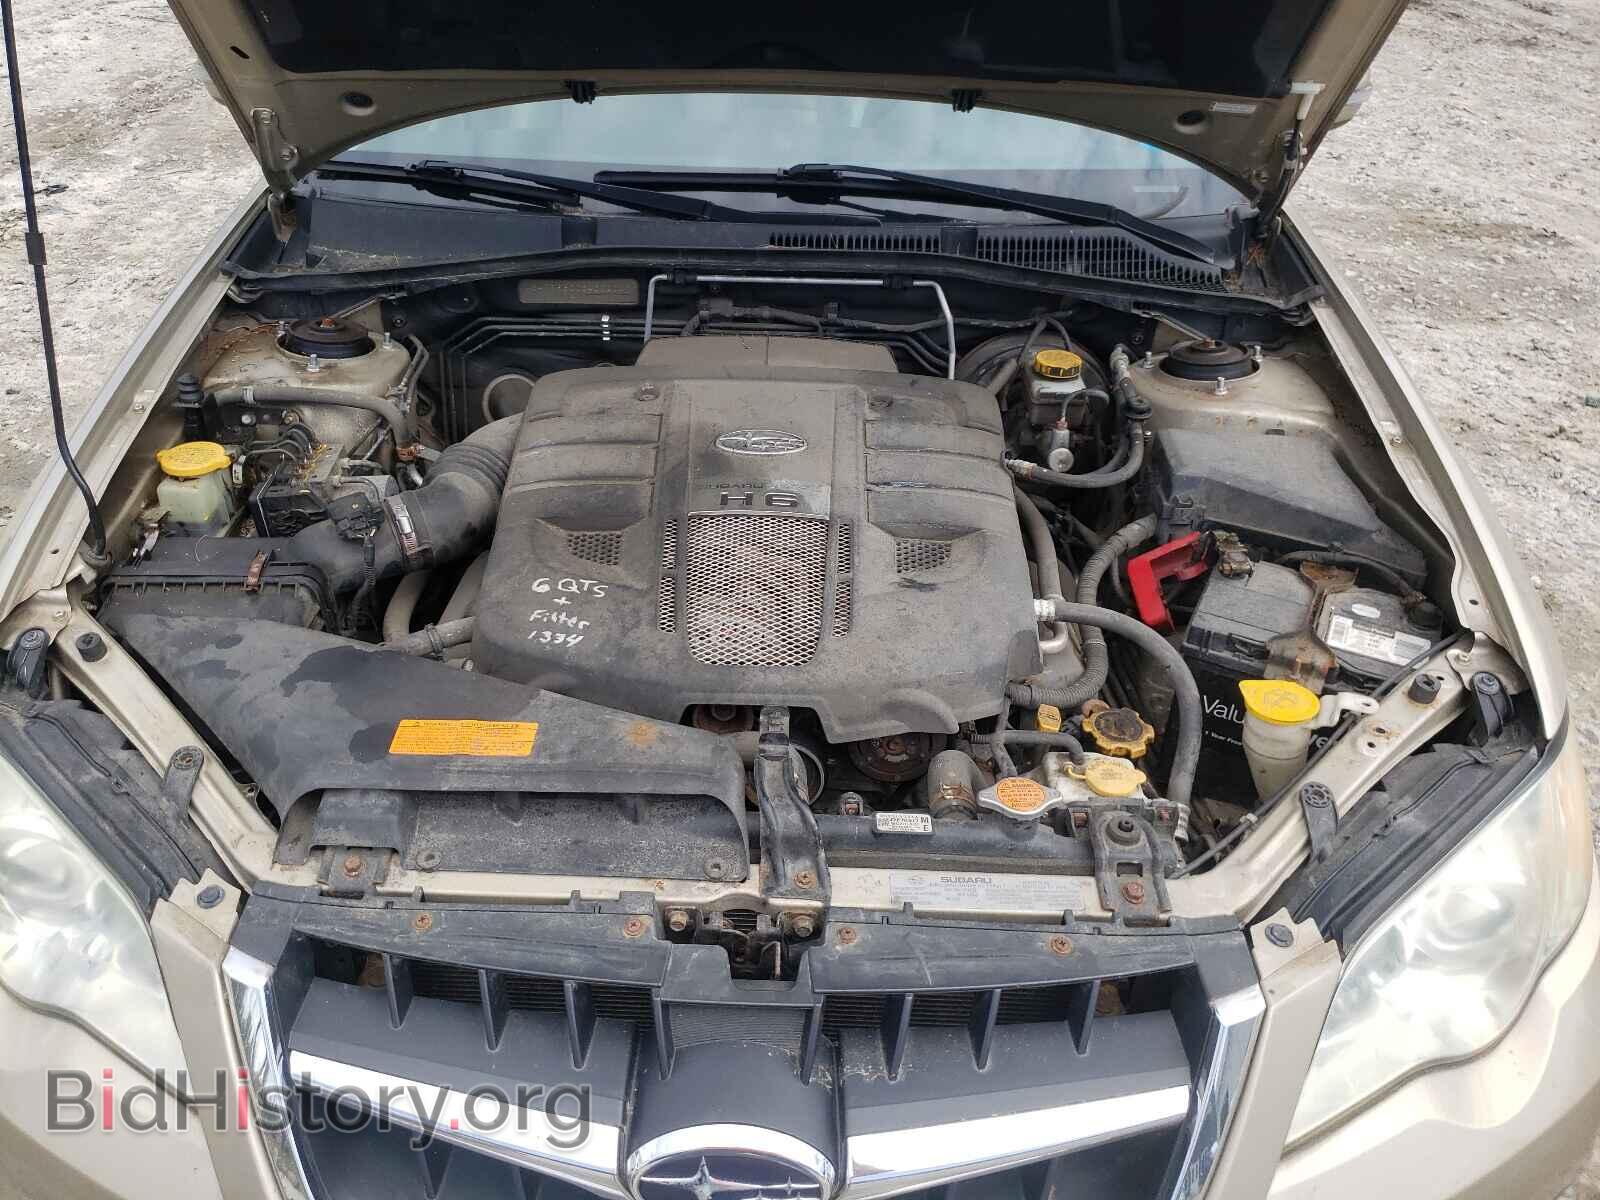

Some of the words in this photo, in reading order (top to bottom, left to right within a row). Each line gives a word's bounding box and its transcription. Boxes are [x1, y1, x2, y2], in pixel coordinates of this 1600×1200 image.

[532, 578, 550, 593] 6
[558, 578, 608, 597] QTS
[1203, 695, 1244, 724] Valu
[940, 876, 992, 884] SUBARU
